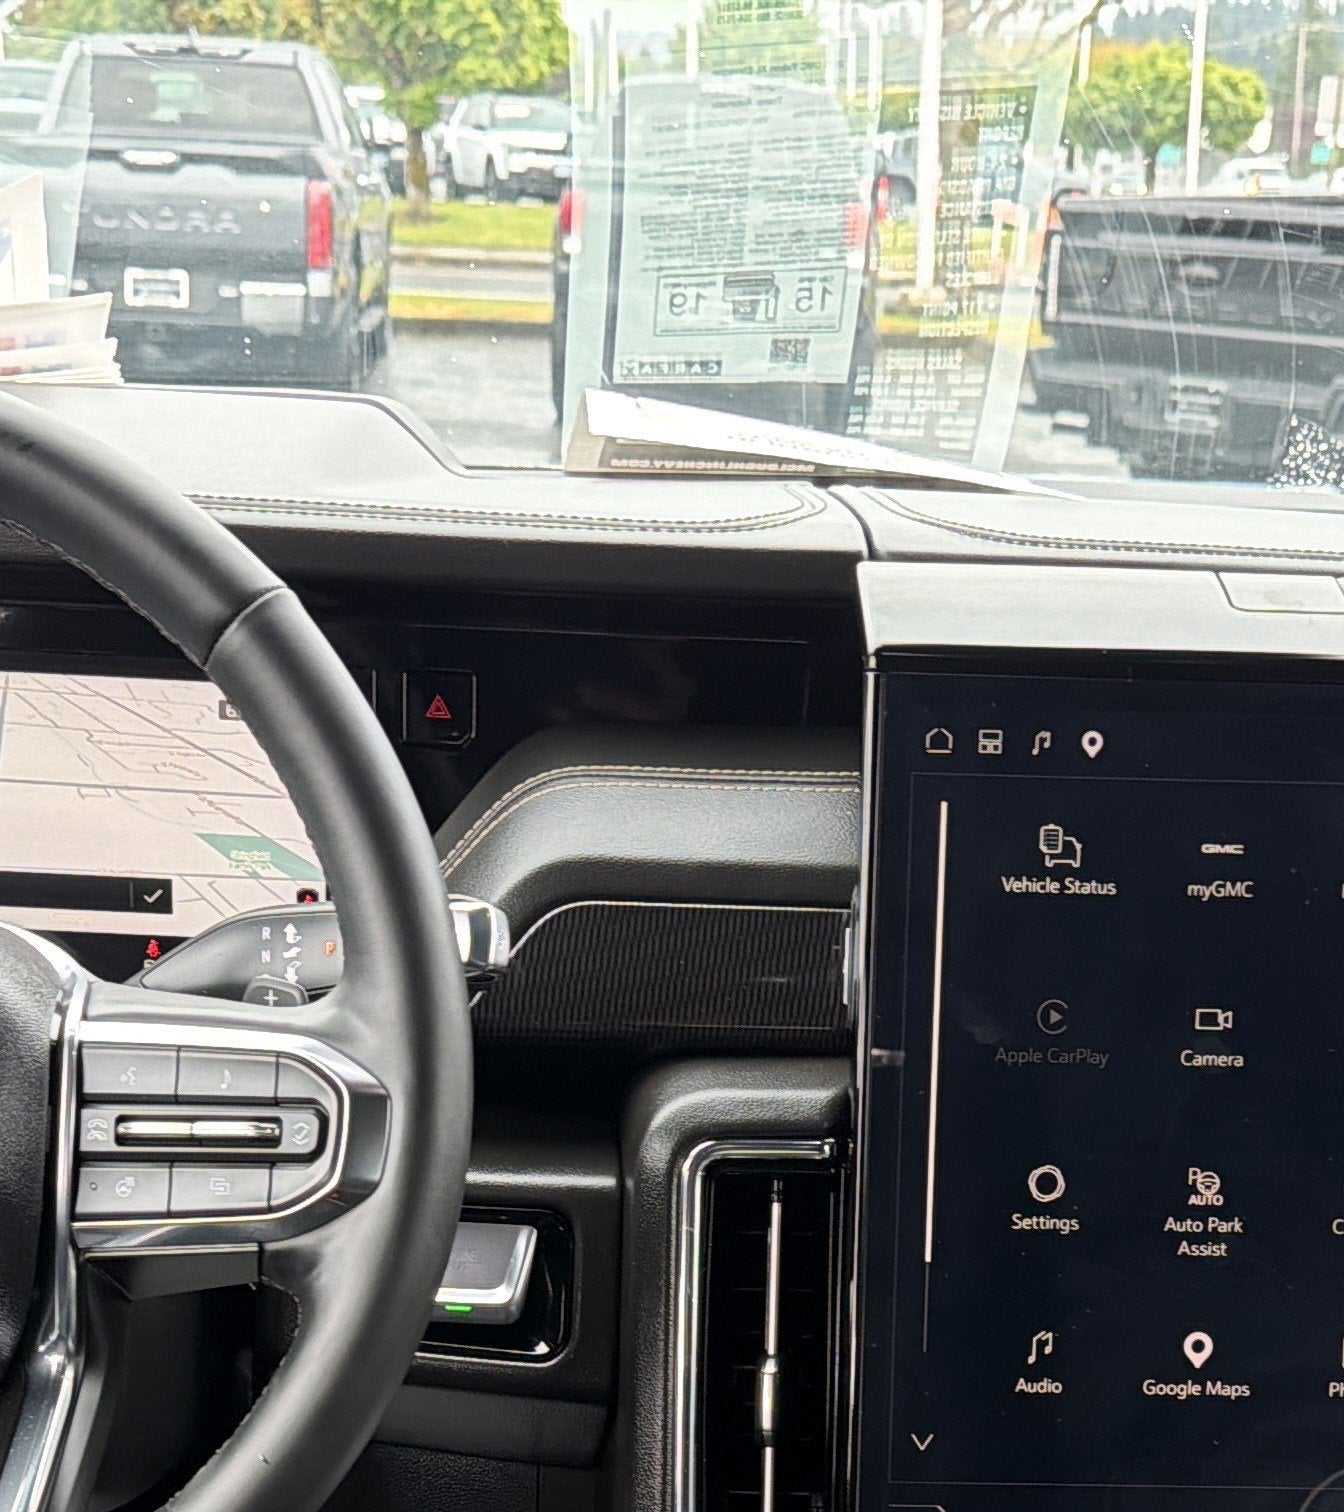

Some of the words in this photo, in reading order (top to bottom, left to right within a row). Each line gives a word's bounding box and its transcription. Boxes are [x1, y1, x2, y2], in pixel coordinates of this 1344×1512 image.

[1200, 843, 1245, 855] GMC
[1001, 876, 1060, 895] Vehicle
[1065, 878, 1117, 896] Status
[1187, 881, 1254, 901] myGMC
[262, 927, 271, 940] R
[262, 950, 271, 963] N
[325, 941, 336, 957] P
[995, 1047, 1043, 1066] Apple
[1047, 1049, 1109, 1068] CarPlay
[1180, 1050, 1244, 1067] Camera
[1011, 1214, 1080, 1234] Settings
[1164, 1217, 1204, 1233] Auto
[1208, 1217, 1243, 1234] Park
[1177, 1241, 1227, 1257] Assist
[1015, 1377, 1063, 1394] Audio
[1143, 1380, 1201, 1398] Google
[1206, 1381, 1251, 1398] Maps
